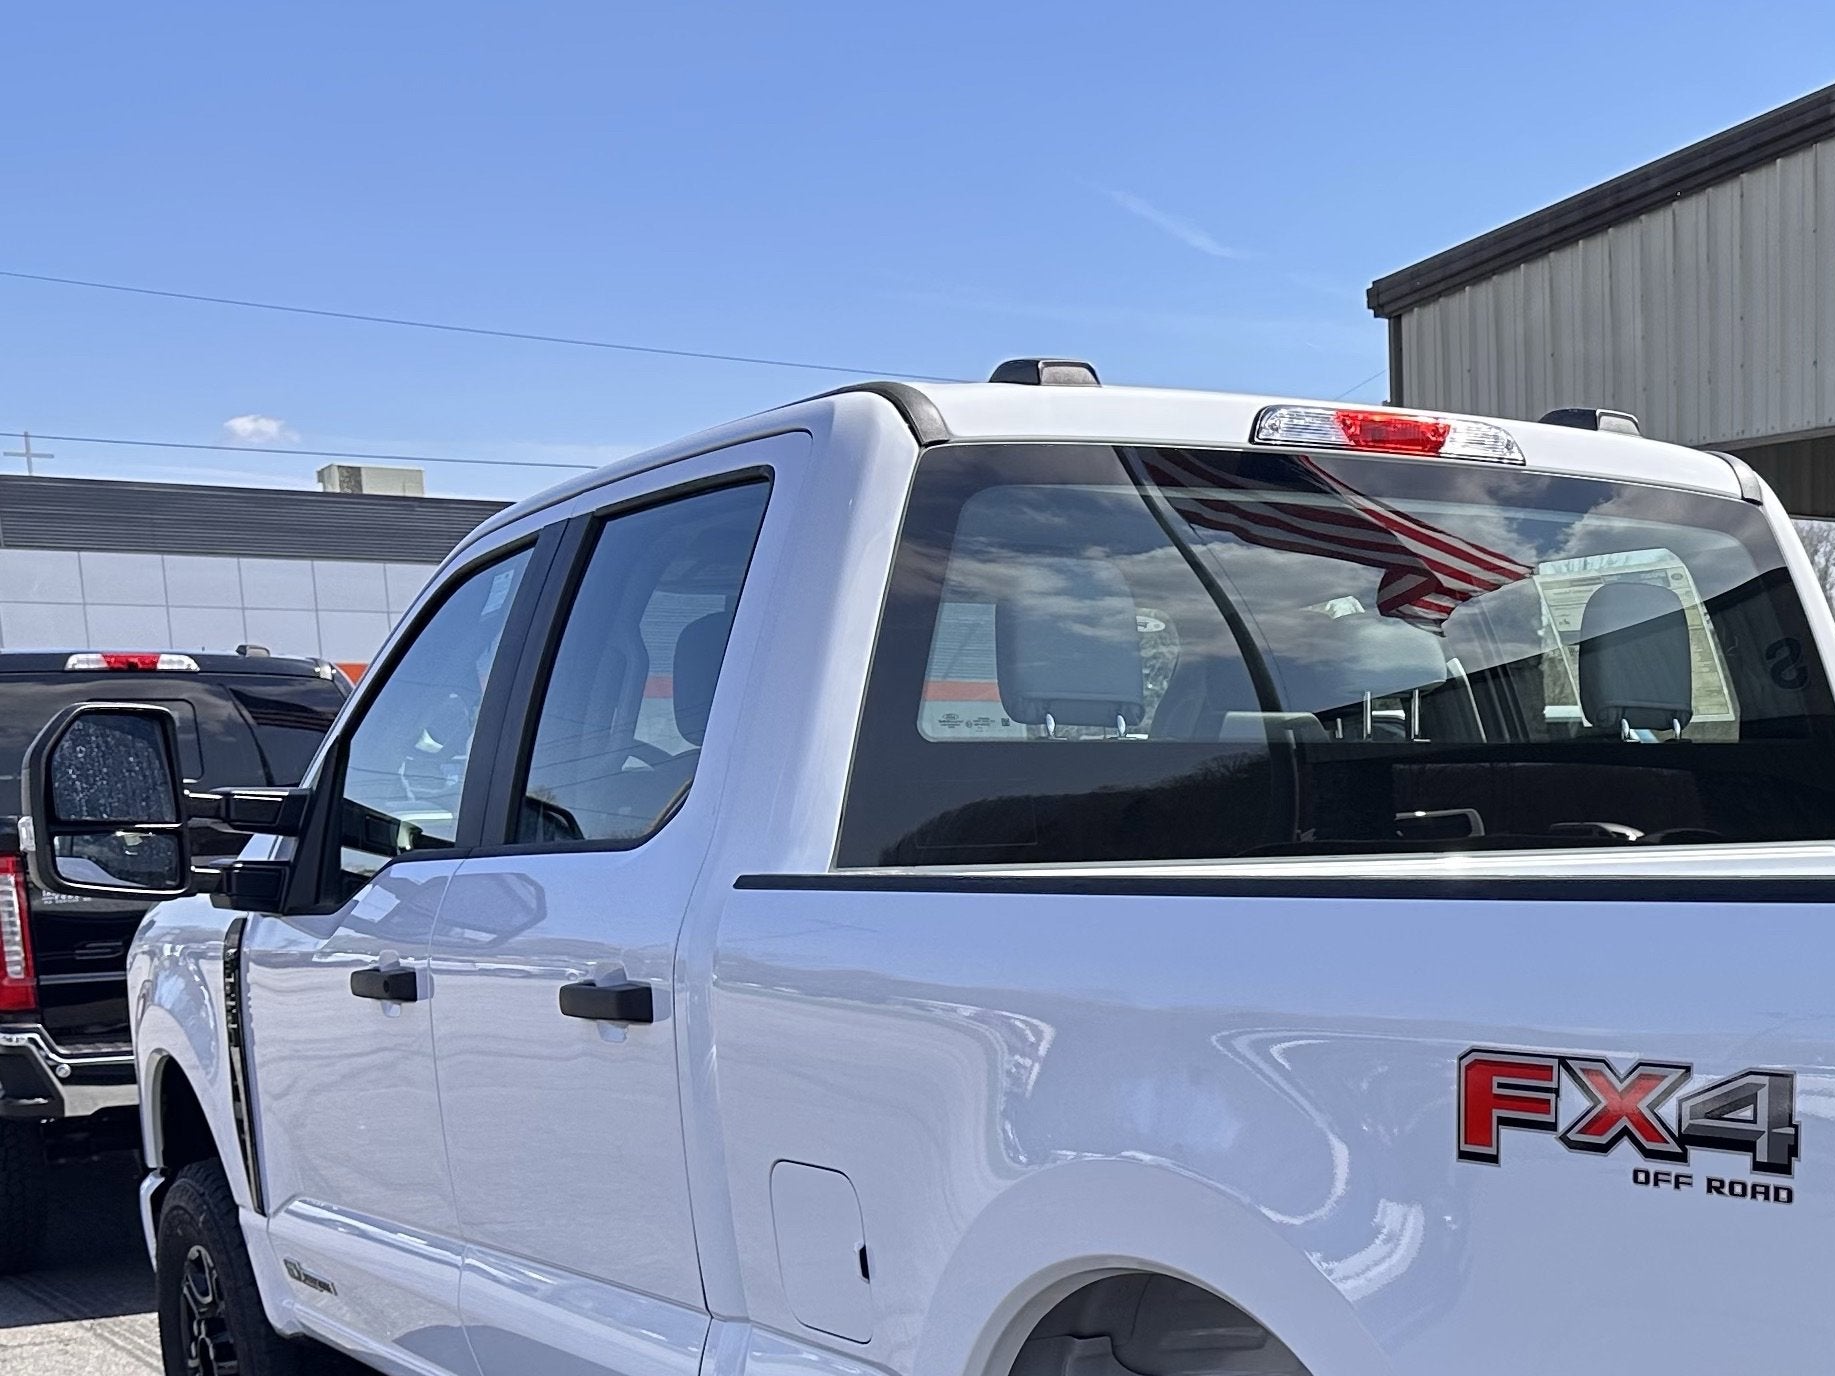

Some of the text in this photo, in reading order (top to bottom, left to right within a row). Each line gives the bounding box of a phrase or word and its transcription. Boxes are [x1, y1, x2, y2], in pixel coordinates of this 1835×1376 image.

[1457, 1046, 1801, 1176] FX4
[1633, 1167, 1794, 1205] OFF ROAD
